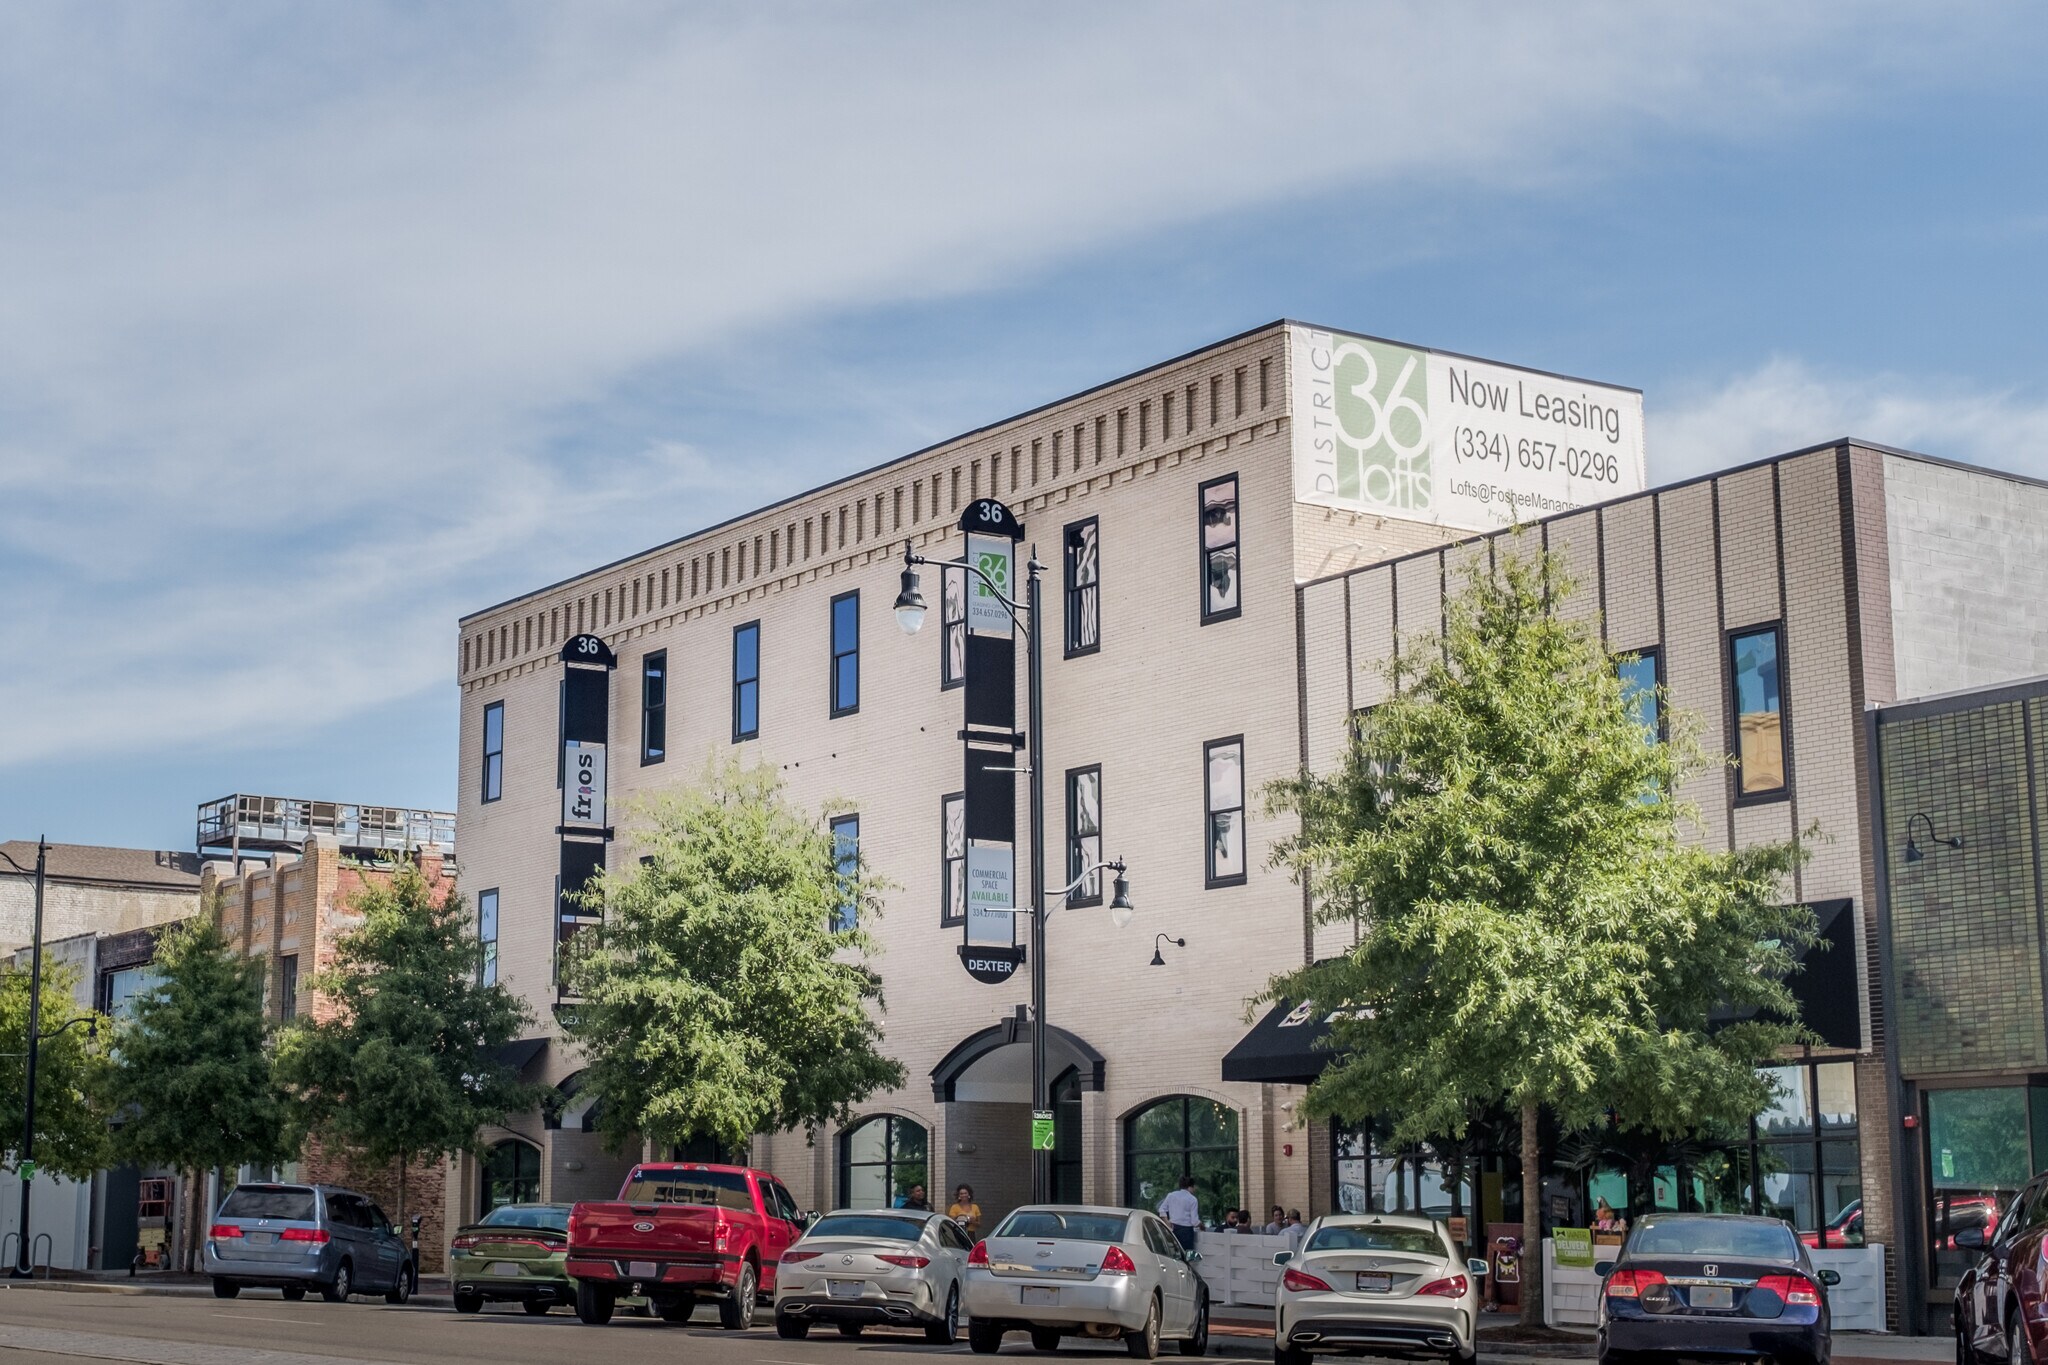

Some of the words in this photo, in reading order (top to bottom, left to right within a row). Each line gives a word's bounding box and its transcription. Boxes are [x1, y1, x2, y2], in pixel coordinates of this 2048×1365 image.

[1333, 342, 1431, 459] 36
[1449, 367, 1508, 412] Now
[1518, 380, 1620, 444] Leasing
[1311, 329, 1335, 494] DISTRICT
[1454, 426, 1510, 472] (334)
[1518, 438, 1619, 484] 657-0296
[1357, 449, 1432, 512] lofts
[980, 502, 1003, 523] 36
[578, 637, 599, 654] 36
[972, 869, 1008, 880] COMMERCIAL
[981, 880, 998, 890] SPACE
[971, 891, 1009, 902] AVAILABLE
[968, 959, 1012, 973] DEXTER
[1556, 1240, 1589, 1250] DELIVERY
